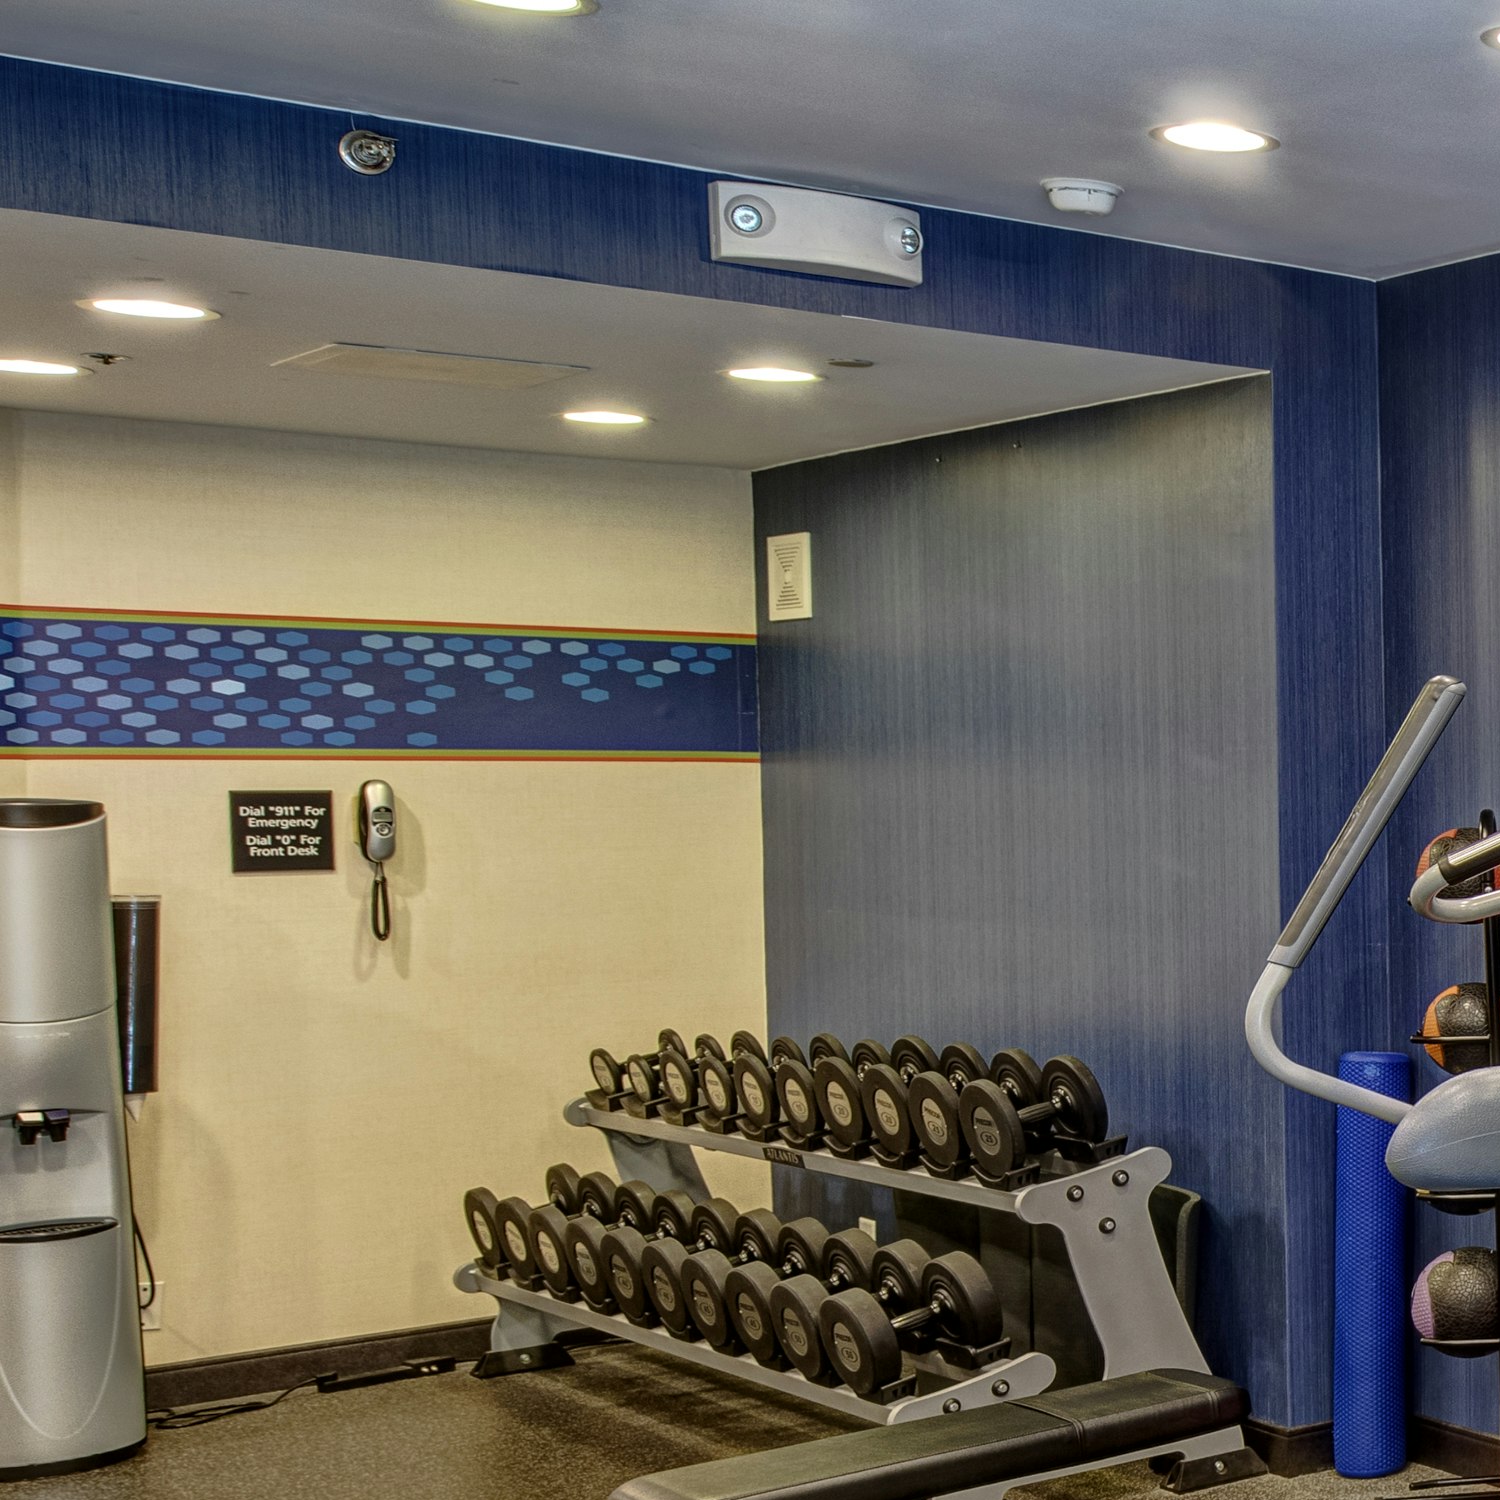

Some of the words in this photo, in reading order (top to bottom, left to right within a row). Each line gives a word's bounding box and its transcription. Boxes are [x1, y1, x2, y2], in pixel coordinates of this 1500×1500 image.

[239, 805, 265, 817] Dial
[268, 805, 301, 816] "911"
[304, 805, 327, 816] For
[247, 818, 319, 829] Emergency
[245, 835, 272, 846] Dial
[300, 834, 322, 845] For
[249, 846, 285, 857] Front
[287, 846, 319, 856] Desk
